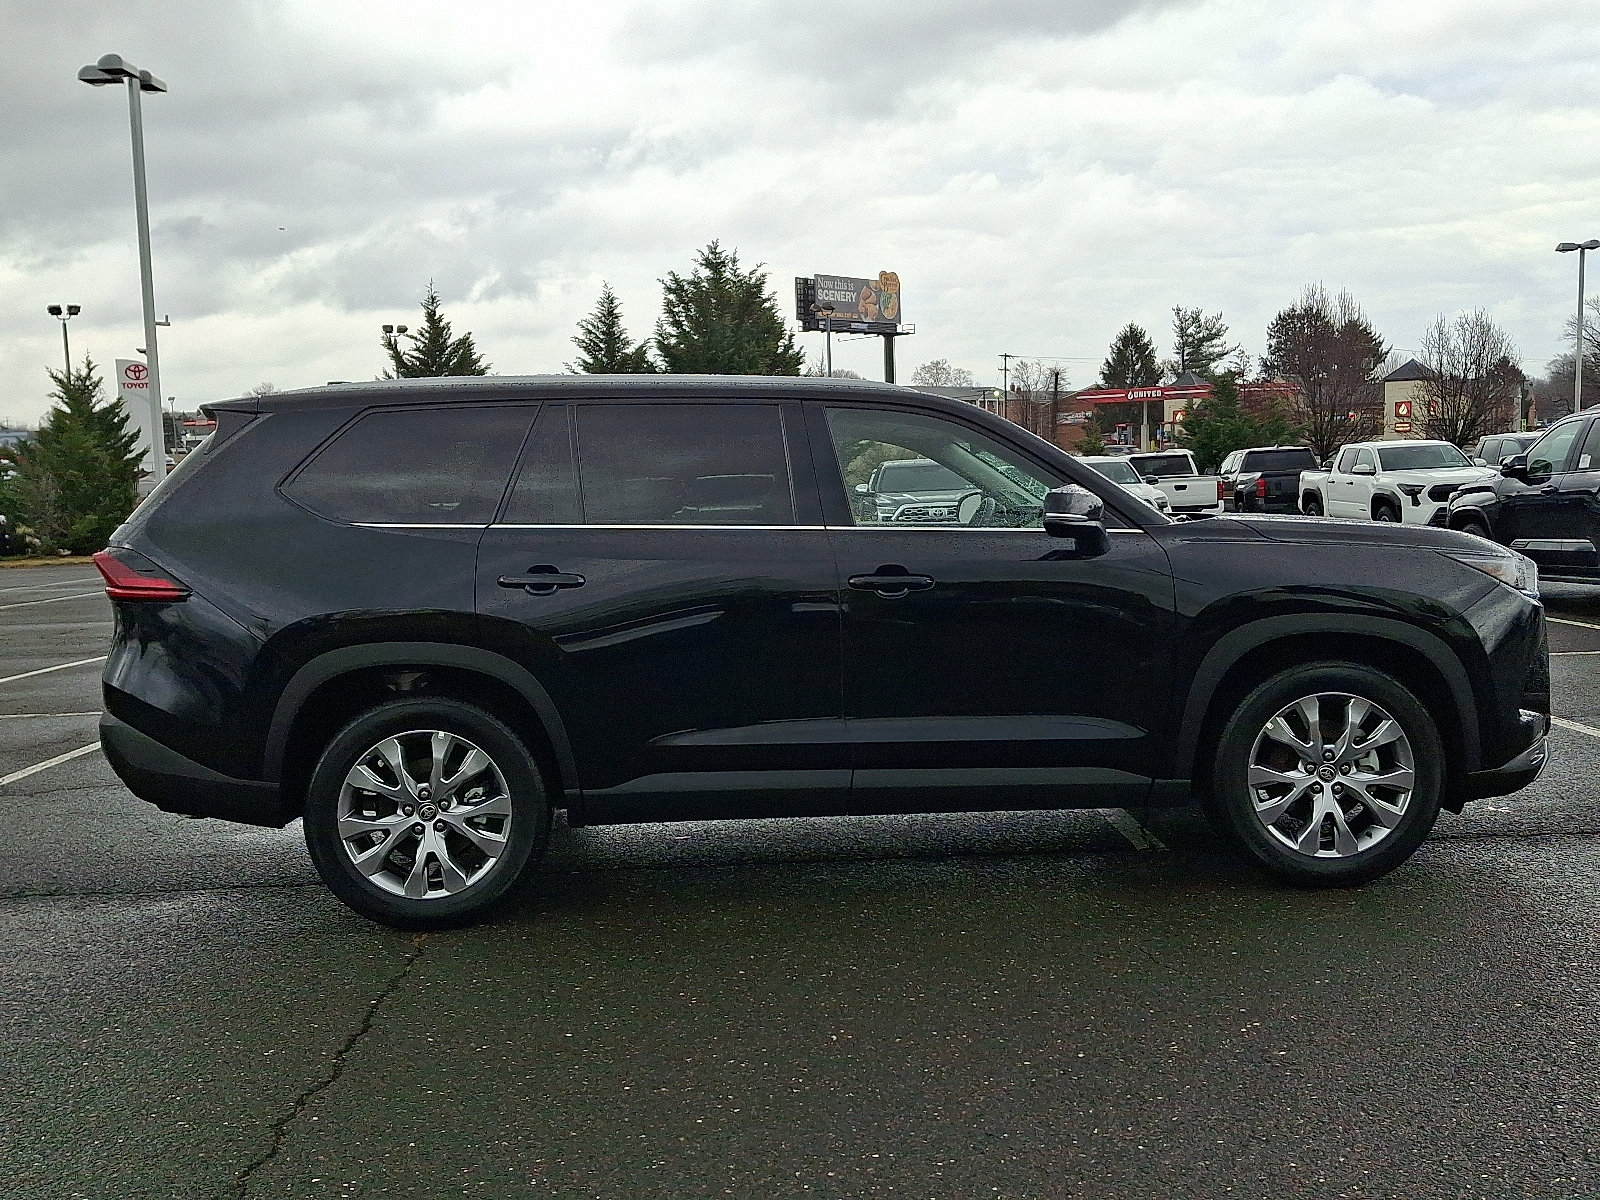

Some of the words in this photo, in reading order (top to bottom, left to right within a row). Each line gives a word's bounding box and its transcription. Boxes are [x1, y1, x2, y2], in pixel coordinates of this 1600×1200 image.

[817, 277, 833, 288] Now
[834, 279, 848, 290] this
[848, 280, 854, 291] is
[817, 288, 857, 302] SCENERY
[1133, 390, 1162, 398] UNITED
